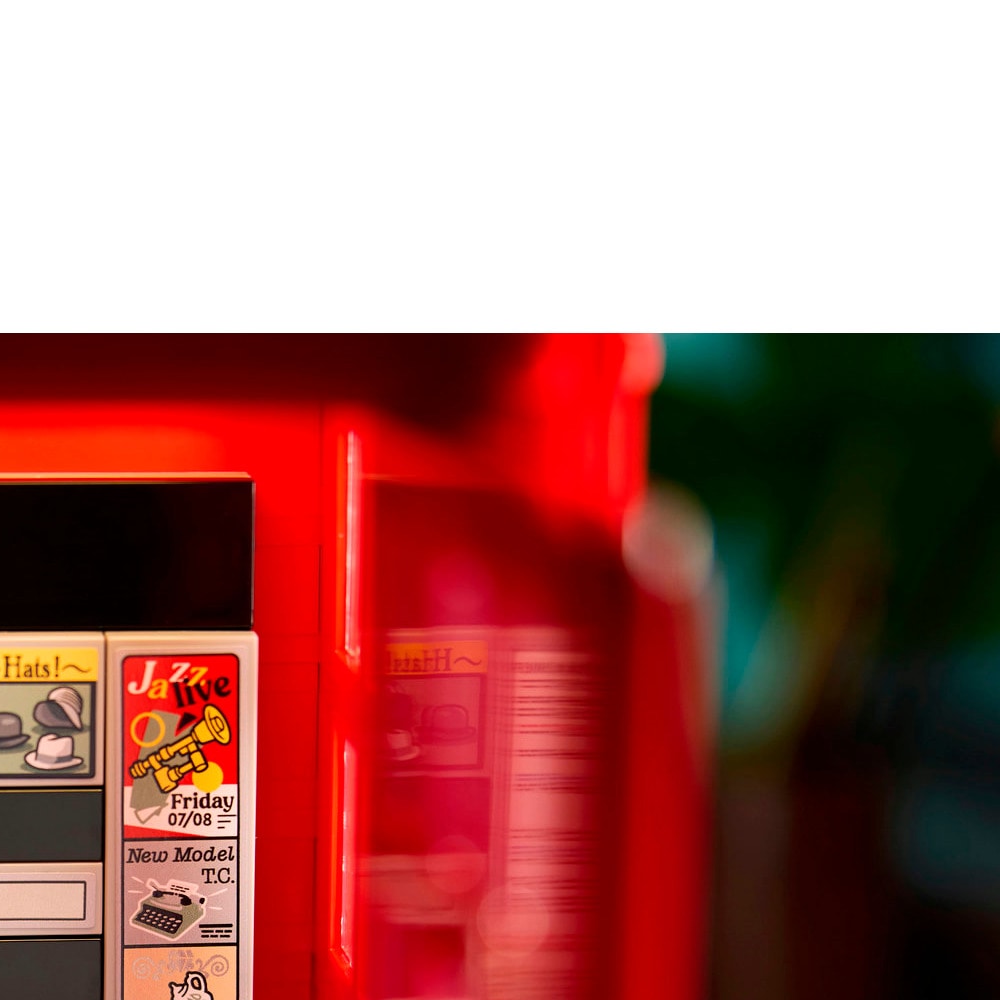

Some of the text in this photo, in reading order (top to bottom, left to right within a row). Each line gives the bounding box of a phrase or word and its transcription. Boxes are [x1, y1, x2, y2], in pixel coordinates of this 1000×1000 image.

[3, 655, 60, 678] Hats!
[127, 660, 209, 700] Jazz
[172, 676, 232, 709] live
[171, 792, 235, 813] Friday
[167, 811, 212, 828] 07/08
[126, 846, 235, 864] New Model
[201, 867, 236, 884] T.C.
